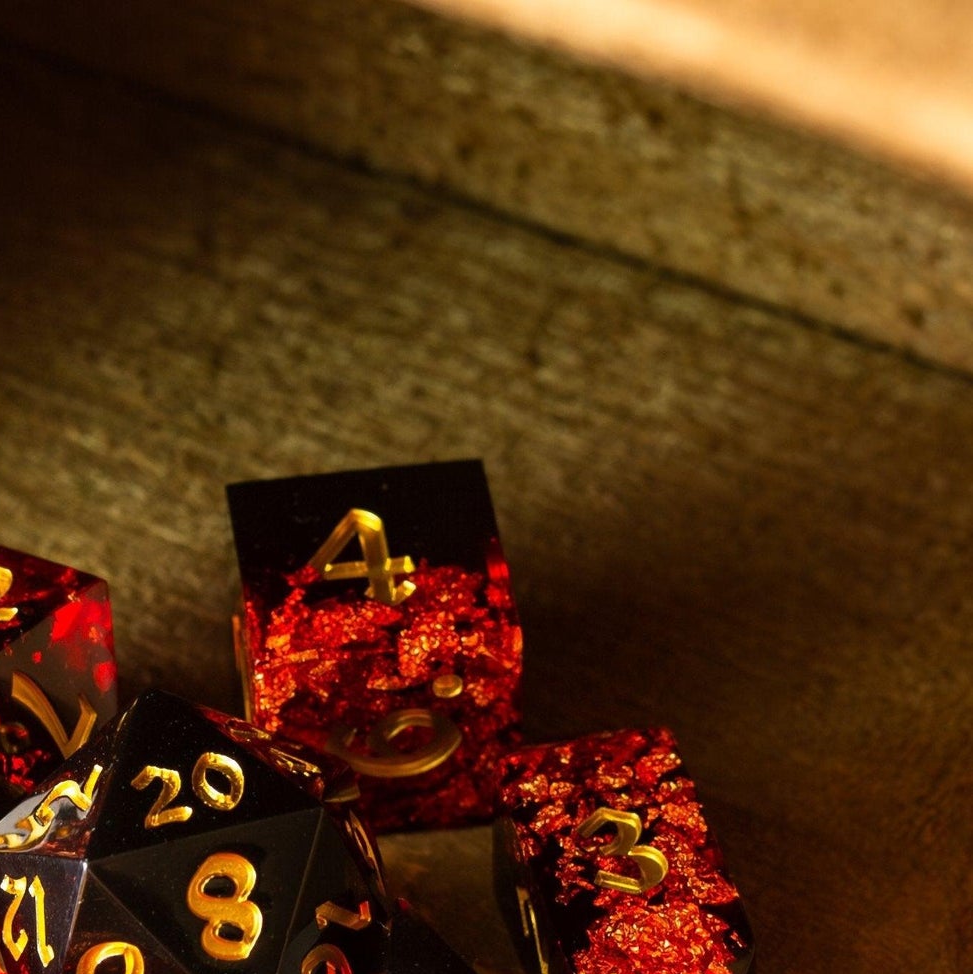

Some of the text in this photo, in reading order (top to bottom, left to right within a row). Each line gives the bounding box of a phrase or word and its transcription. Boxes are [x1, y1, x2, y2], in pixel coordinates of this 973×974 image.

[308, 507, 417, 605] 4
[130, 751, 245, 830] 20
[577, 805, 669, 894] 3
[186, 851, 264, 961] 8
